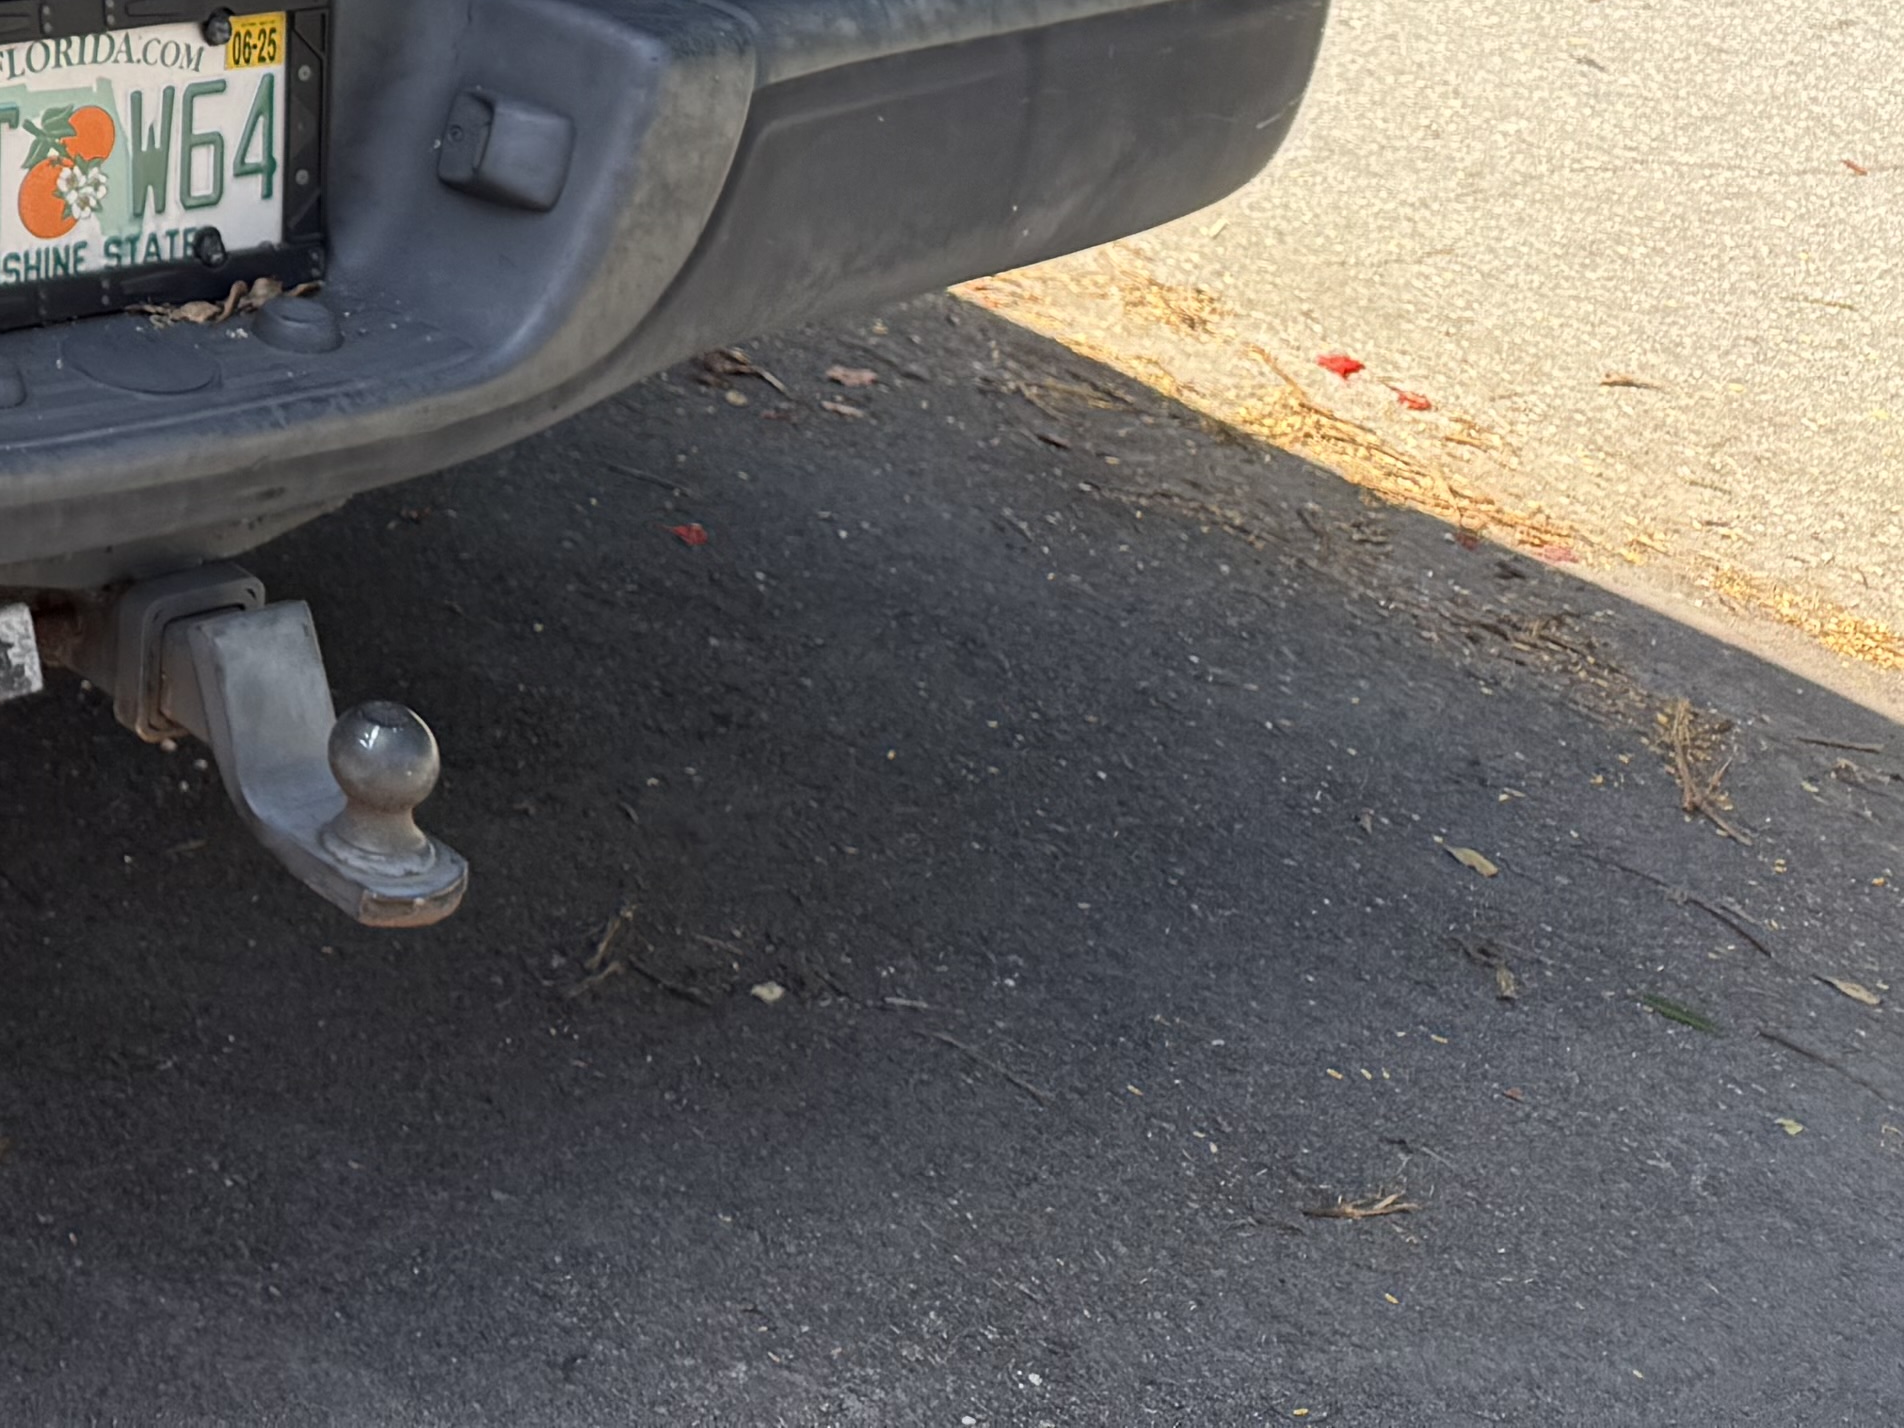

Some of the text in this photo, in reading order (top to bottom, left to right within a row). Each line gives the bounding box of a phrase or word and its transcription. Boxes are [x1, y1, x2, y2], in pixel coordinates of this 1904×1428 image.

[232, 27, 277, 66] 06-25
[129, 71, 278, 219] W64
[103, 226, 198, 270] STATE
